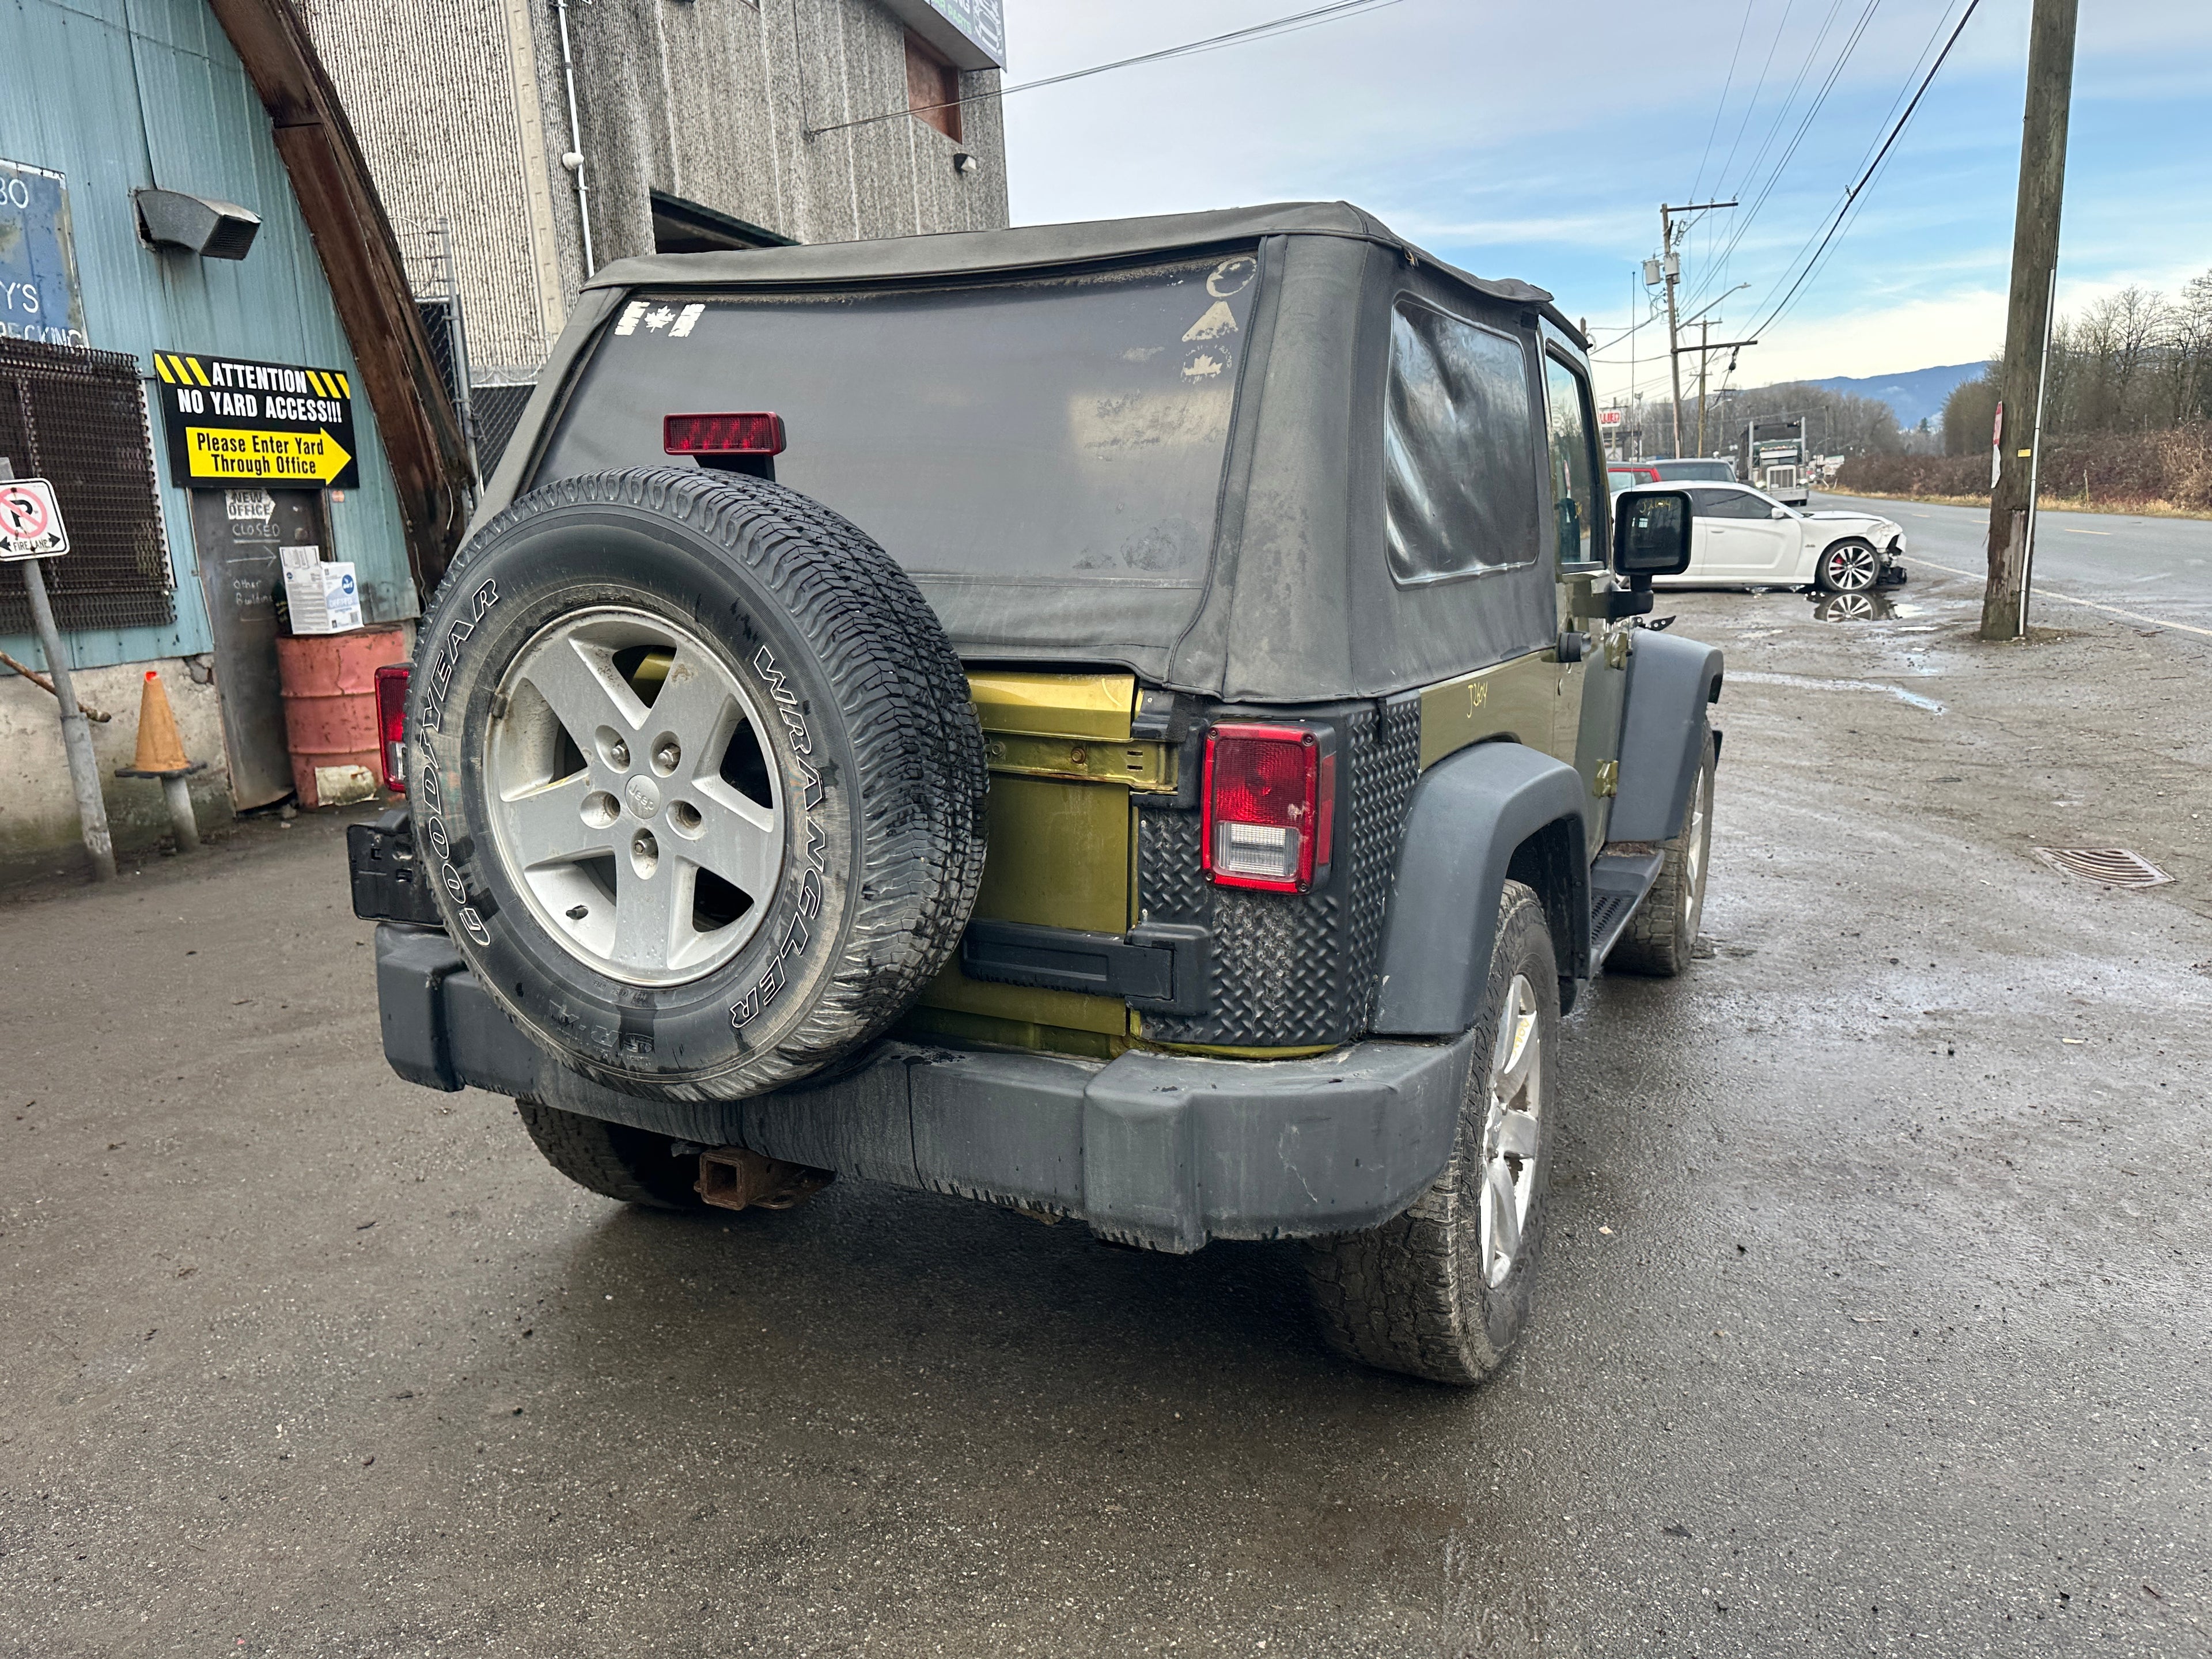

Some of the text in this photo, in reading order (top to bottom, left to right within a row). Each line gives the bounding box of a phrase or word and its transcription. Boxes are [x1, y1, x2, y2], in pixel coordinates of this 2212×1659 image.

[948, 3, 972, 35] PARTS
[212, 362, 308, 394] ATTENTION
[176, 388, 343, 423] NO YARD ACCESS!!!
[196, 433, 324, 456] Please Enter Yard
[211, 454, 316, 476] Through Office
[229, 502, 272, 516] OFFICE
[231, 491, 263, 503] NEW
[232, 522, 281, 537] CLOSED
[13, 539, 51, 551] FIRE LANE
[419, 578, 499, 946] GOODYEAR
[628, 784, 654, 810] Jeep
[729, 645, 825, 1028] WRANGLER
